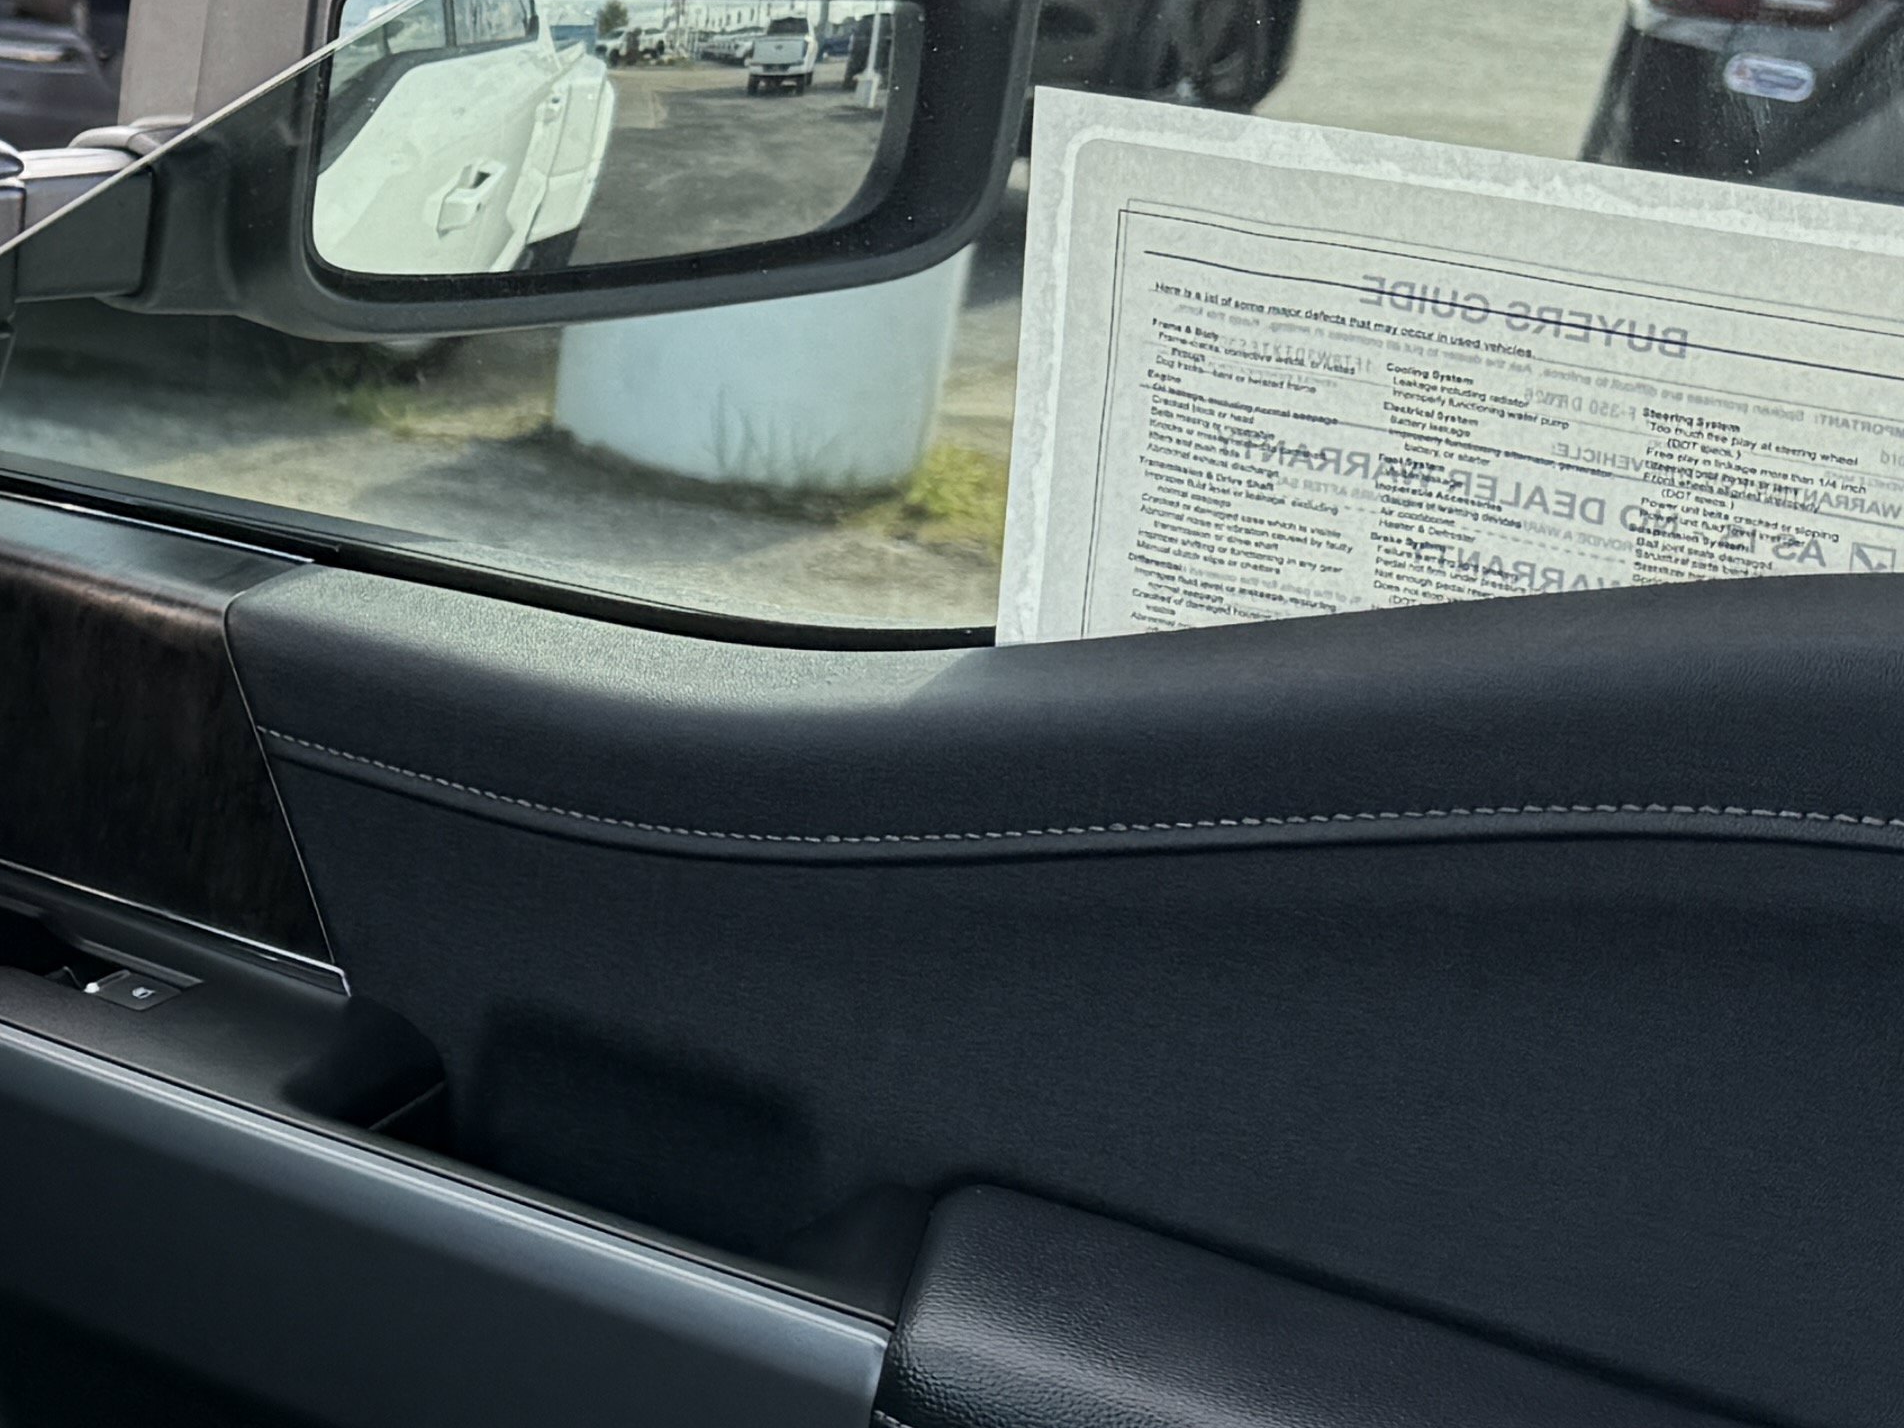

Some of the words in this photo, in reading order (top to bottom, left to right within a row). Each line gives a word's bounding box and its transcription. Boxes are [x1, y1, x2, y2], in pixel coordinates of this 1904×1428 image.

[1155, 282, 1180, 296] Here
[1221, 296, 1233, 307] of
[1234, 301, 1264, 313] some
[1268, 306, 1301, 319] major
[1304, 309, 1346, 325] defects
[1349, 317, 1371, 330] that
[1374, 323, 1397, 336] may
[1401, 327, 1434, 341] occur
[1437, 332, 1447, 343] in
[1451, 336, 1480, 349] used
[1484, 341, 1537, 359] vehicles.
[1643, 408, 1693, 426] Steering
[1650, 422, 1671, 434] Too
